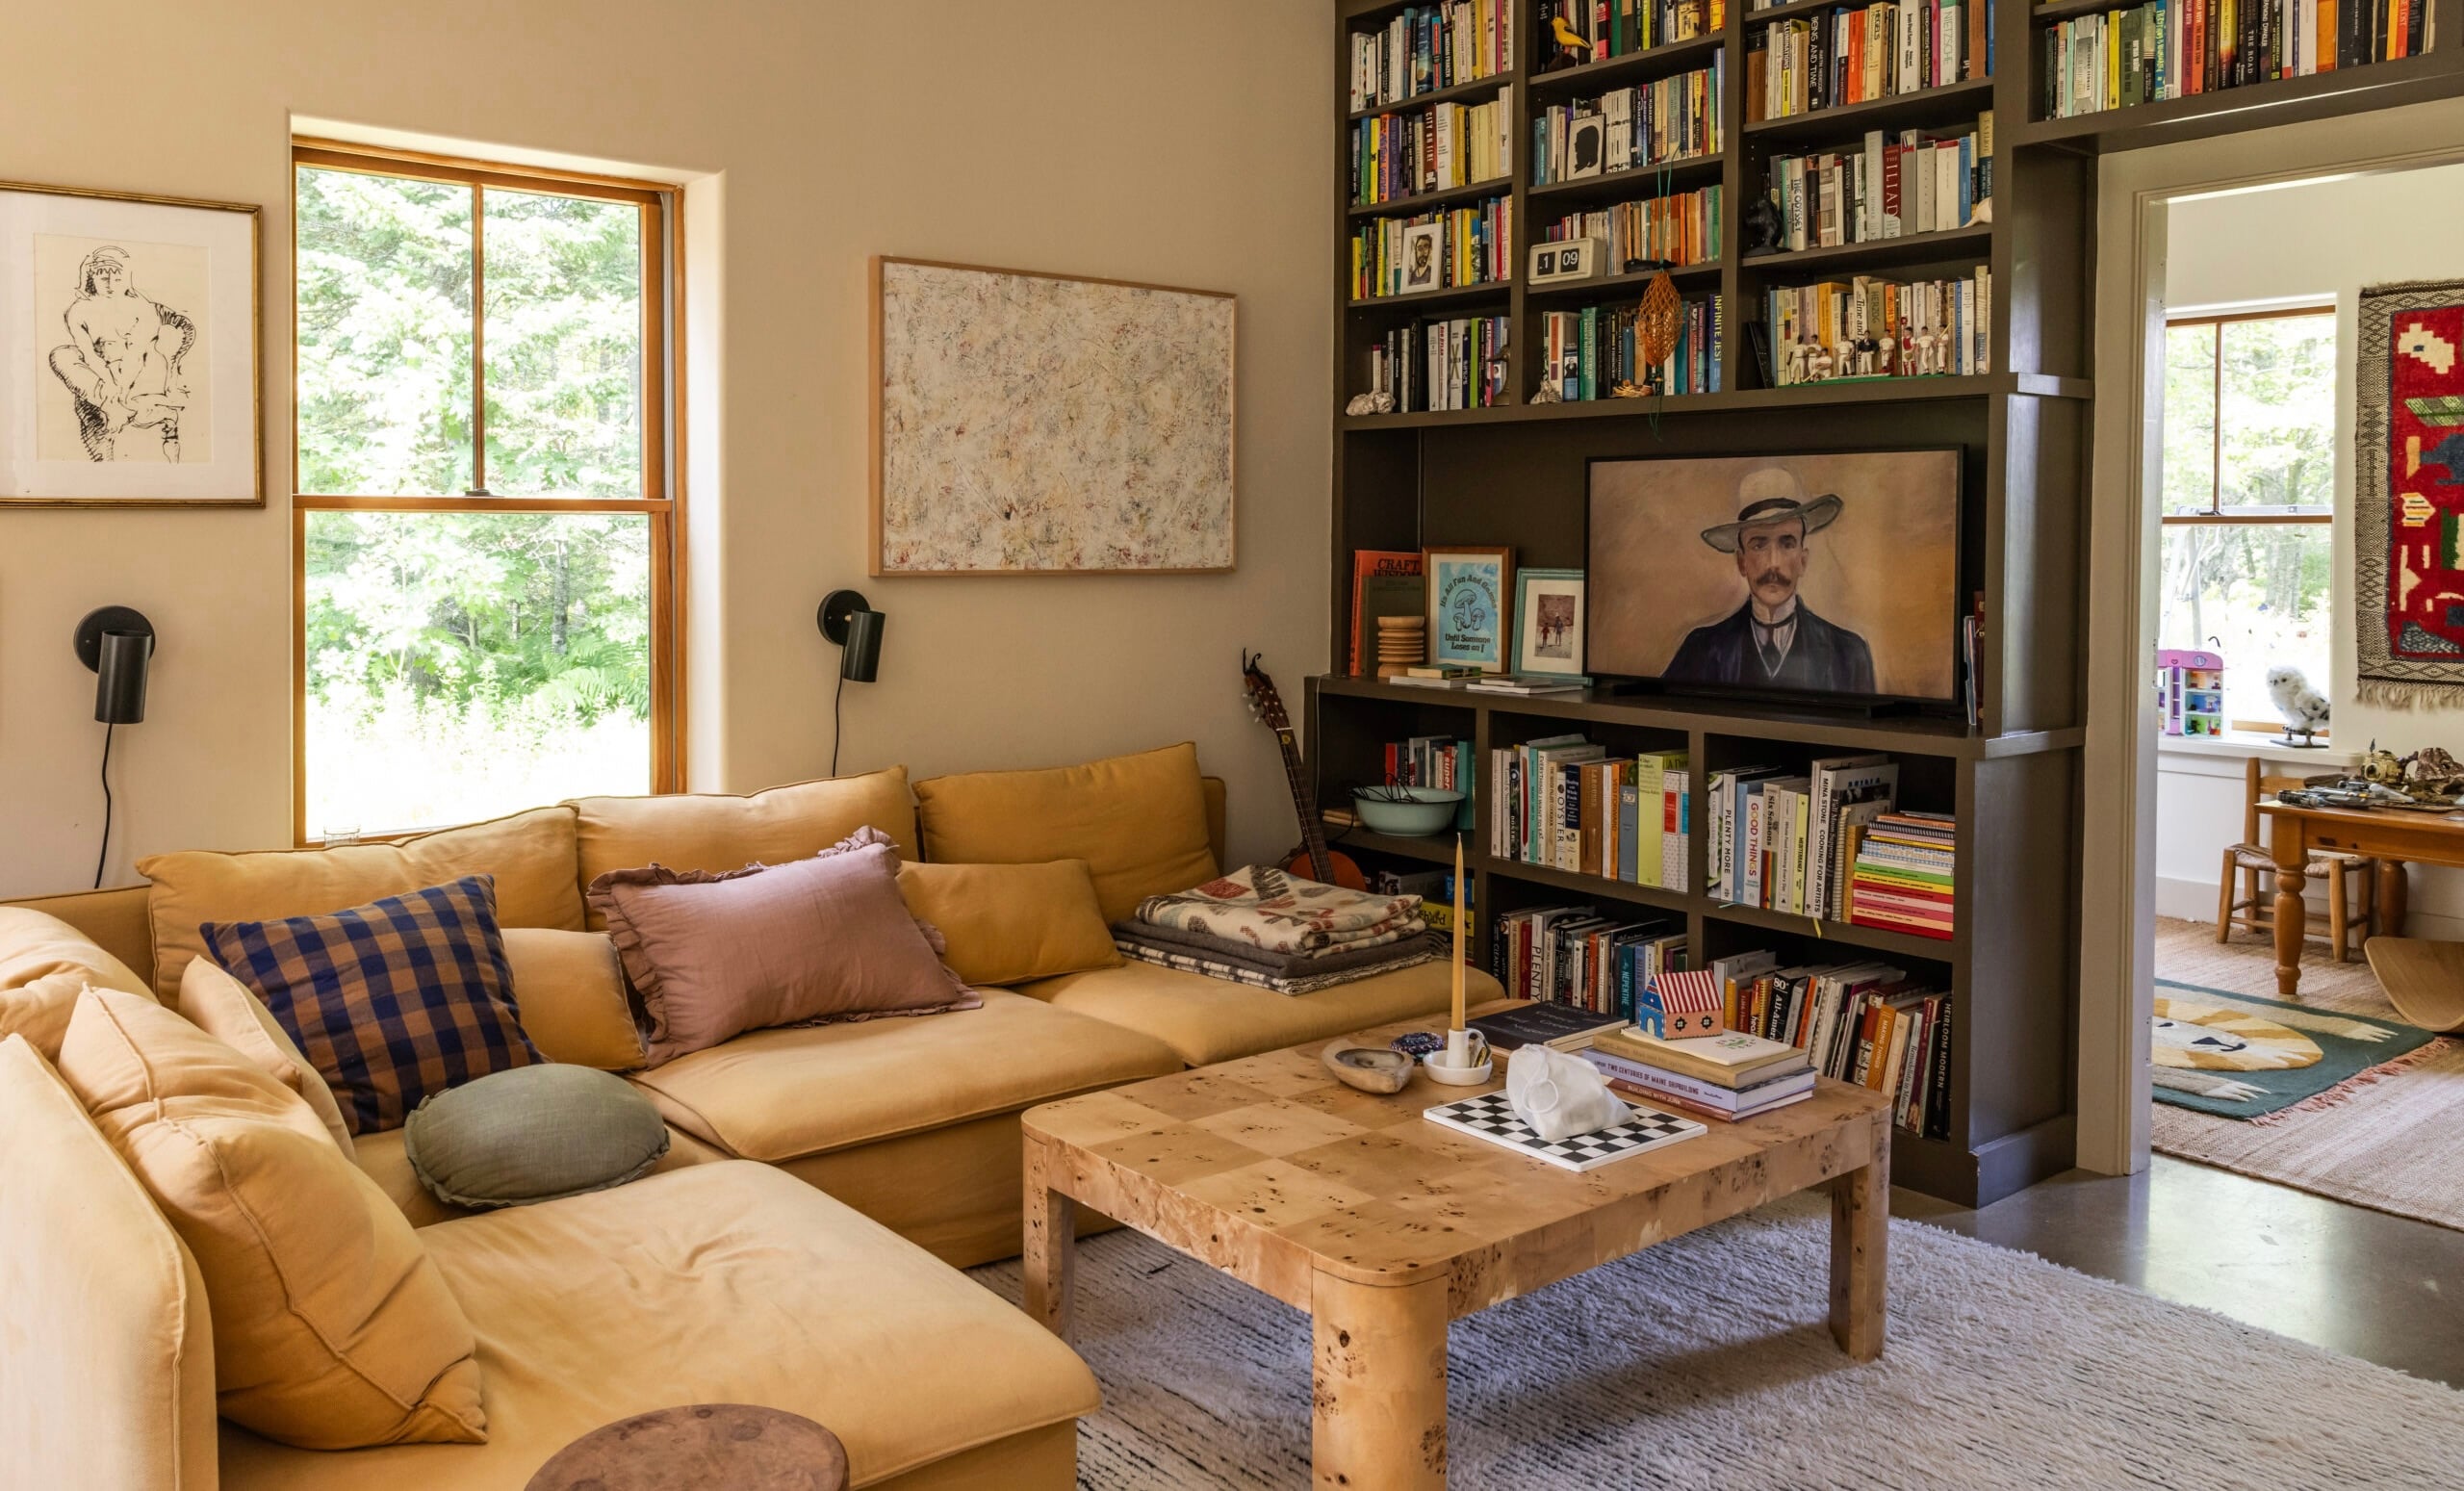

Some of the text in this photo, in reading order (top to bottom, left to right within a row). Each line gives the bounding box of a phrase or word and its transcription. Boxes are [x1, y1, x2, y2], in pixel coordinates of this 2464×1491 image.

[1943, 12, 1953, 65] NIETZSCHE
[1425, 112, 1434, 130] CITY
[1425, 145, 1434, 163] FIRE
[1886, 164, 1899, 217] ILIAD
[1562, 250, 1579, 267] 09
[1856, 299, 1865, 337] Time and
[1871, 291, 1880, 324] HERZOG
[1713, 295, 1723, 364] INFINITE JEST
[1377, 558, 1421, 571] CRAFT
[1452, 576, 1466, 588] Fun
[1466, 574, 1482, 584] And
[1445, 632, 1491, 644] Until Someone
[1450, 641, 1471, 651] Loses
[1749, 802, 1759, 877] GOOD THINGS
[1817, 829, 1826, 864] COOKING
[1531, 945, 1542, 1001] PLENTY
[1622, 970, 1630, 1006] NEPENTHE
[1769, 993, 1783, 1041] All-Ameri
[1879, 1019, 1888, 1044] MAKING
[1937, 1003, 1952, 1089] HEIRLOOM MODERN
[1607, 1062, 1699, 1095] TWO CENTURIES OF MAINE SHIPBUILDING
[1628, 1085, 1653, 1099] BUILDING
[1653, 1092, 1667, 1102] WITH
[1900, 1089, 1909, 1109] Maine
